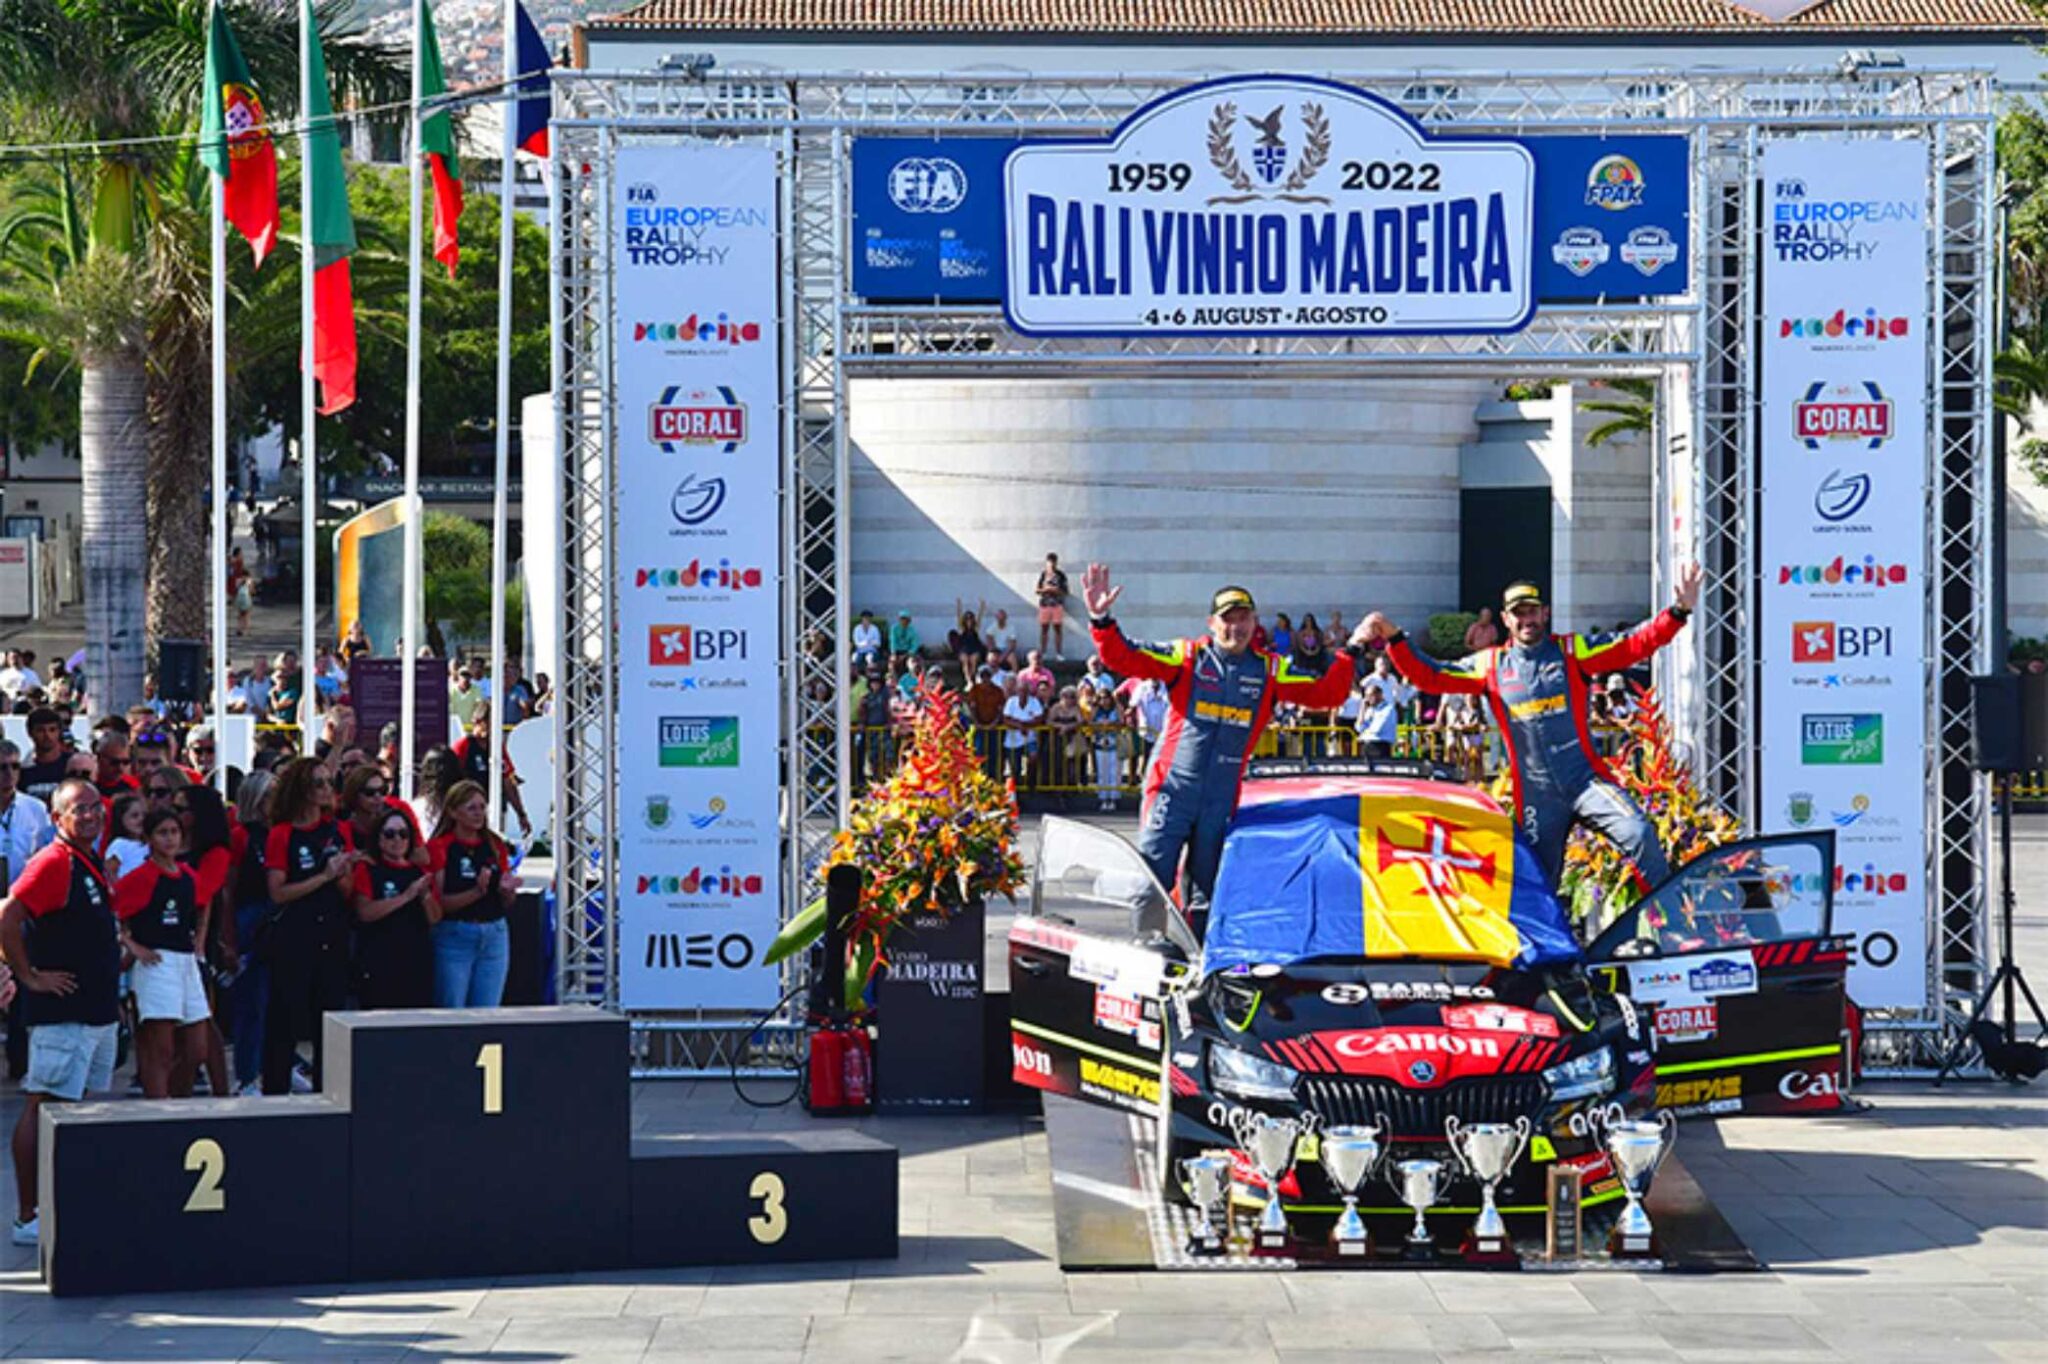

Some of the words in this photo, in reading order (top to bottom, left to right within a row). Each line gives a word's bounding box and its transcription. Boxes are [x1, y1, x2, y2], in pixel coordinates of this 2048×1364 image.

[1108, 164, 1192, 192] 1959
[1341, 162, 1441, 191] 2022
[1776, 183, 1805, 197] FIA
[626, 207, 767, 226] EUROPEAN
[1774, 202, 1917, 221] EUROPEAN
[626, 227, 706, 246] RALLY
[1774, 222, 1855, 241] RALLY
[1027, 193, 1132, 296] RALI
[1143, 209, 1287, 296] VINHO
[1300, 192, 1513, 294] MADEIRA
[1774, 242, 1878, 261] TROPHY
[626, 247, 730, 265] TROPHY
[661, 412, 737, 434] CORAL
[1806, 408, 1883, 430] CORAL
[695, 630, 747, 659] BPI
[1838, 626, 1892, 656] BPI
[663, 726, 710, 742] LOTUS
[1806, 723, 1854, 740] LOTUS
[645, 933, 754, 968] MEO
[887, 963, 977, 981] MADEIRA
[1601, 967, 1617, 993] 7
[1657, 1009, 1717, 1031] CORAL
[1335, 1033, 1499, 1058] Canon
[475, 1043, 503, 1115] 1
[183, 1139, 227, 1213] 2
[748, 1172, 789, 1245] 3
